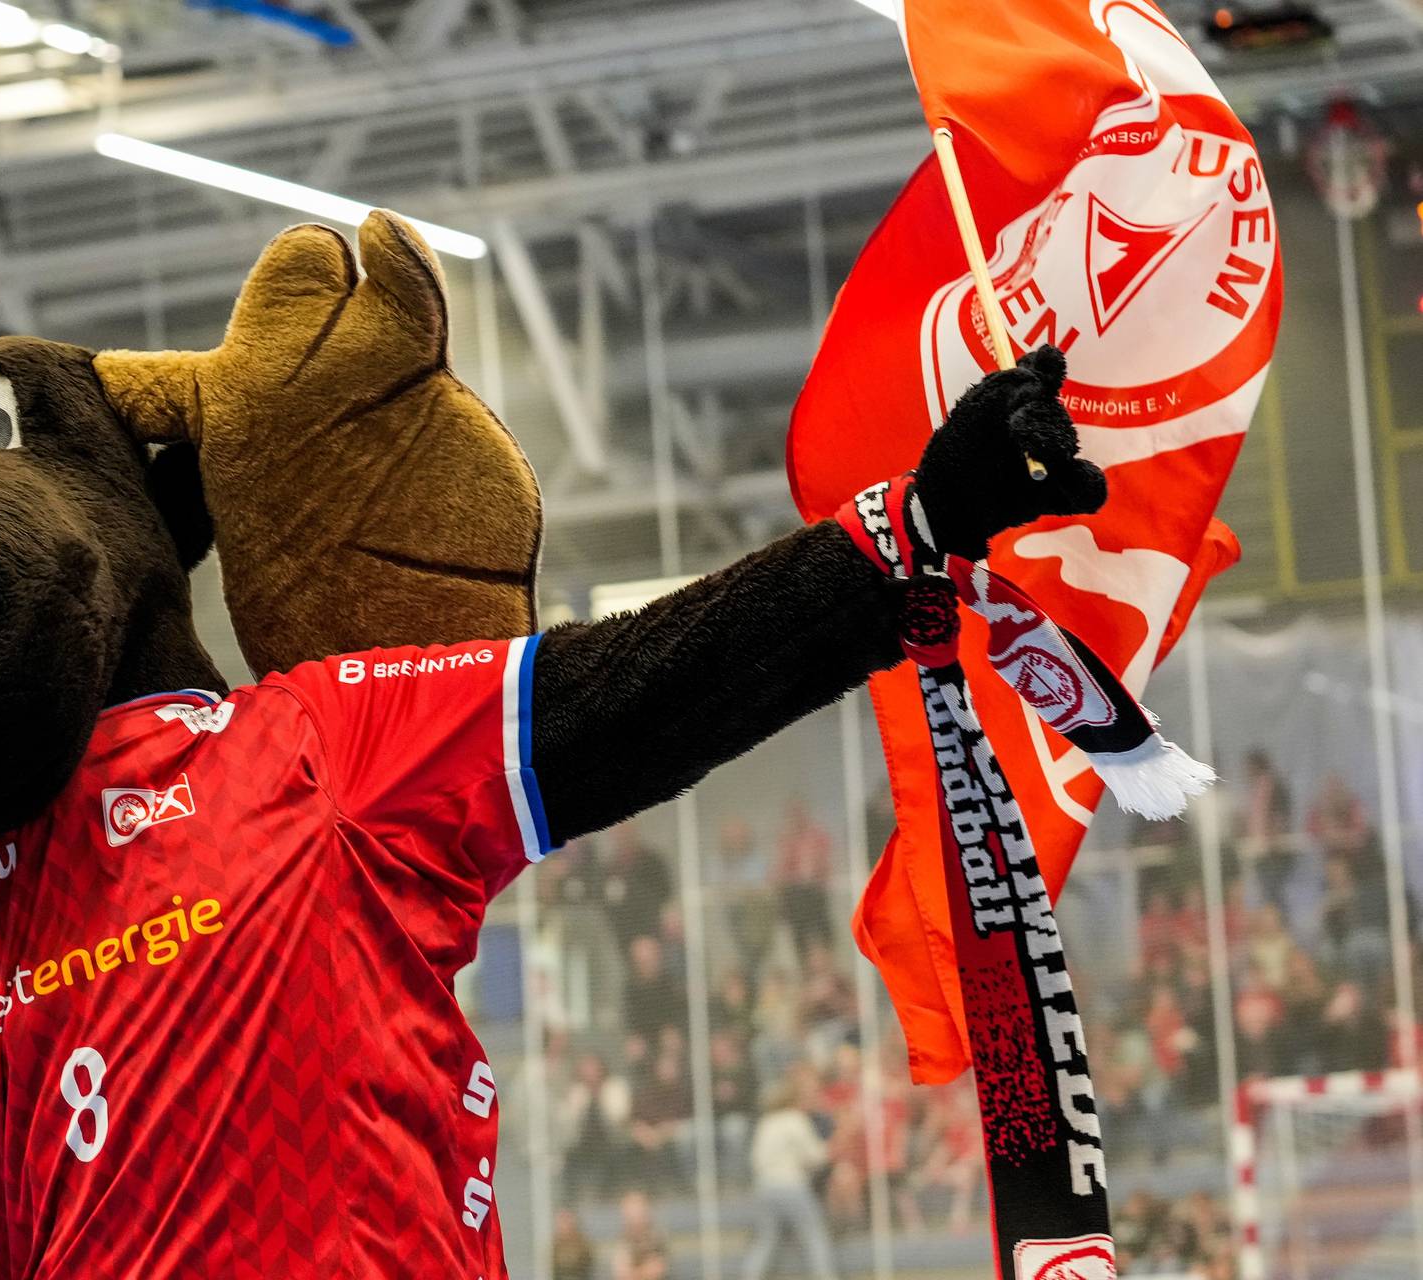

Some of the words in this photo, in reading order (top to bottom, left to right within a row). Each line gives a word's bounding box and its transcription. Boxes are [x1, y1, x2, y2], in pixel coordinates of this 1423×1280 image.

[1171, 137, 1271, 321] USEM
[373, 649, 494, 679] BRENNTAG
[59, 1046, 109, 1163] 8
